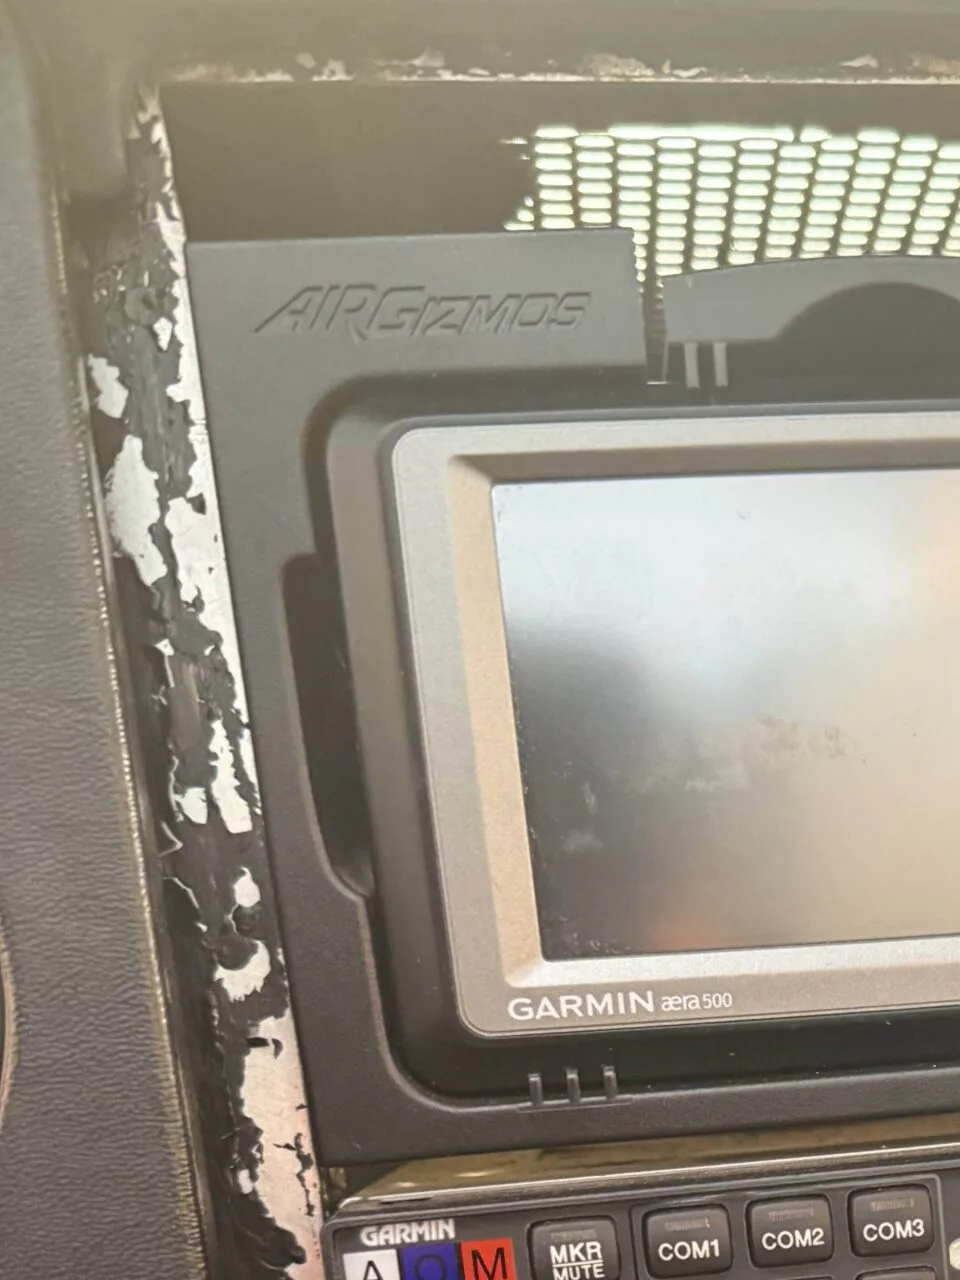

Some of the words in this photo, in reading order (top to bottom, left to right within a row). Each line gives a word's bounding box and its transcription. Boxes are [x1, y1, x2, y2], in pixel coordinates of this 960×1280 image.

[507, 990, 655, 1021] GARMIN
[360, 1218, 456, 1246] GARMIN
[761, 1228, 825, 1251] COM2
[862, 1219, 925, 1242] COM3
[550, 1241, 603, 1264] MKR
[658, 1239, 721, 1262] COM1
